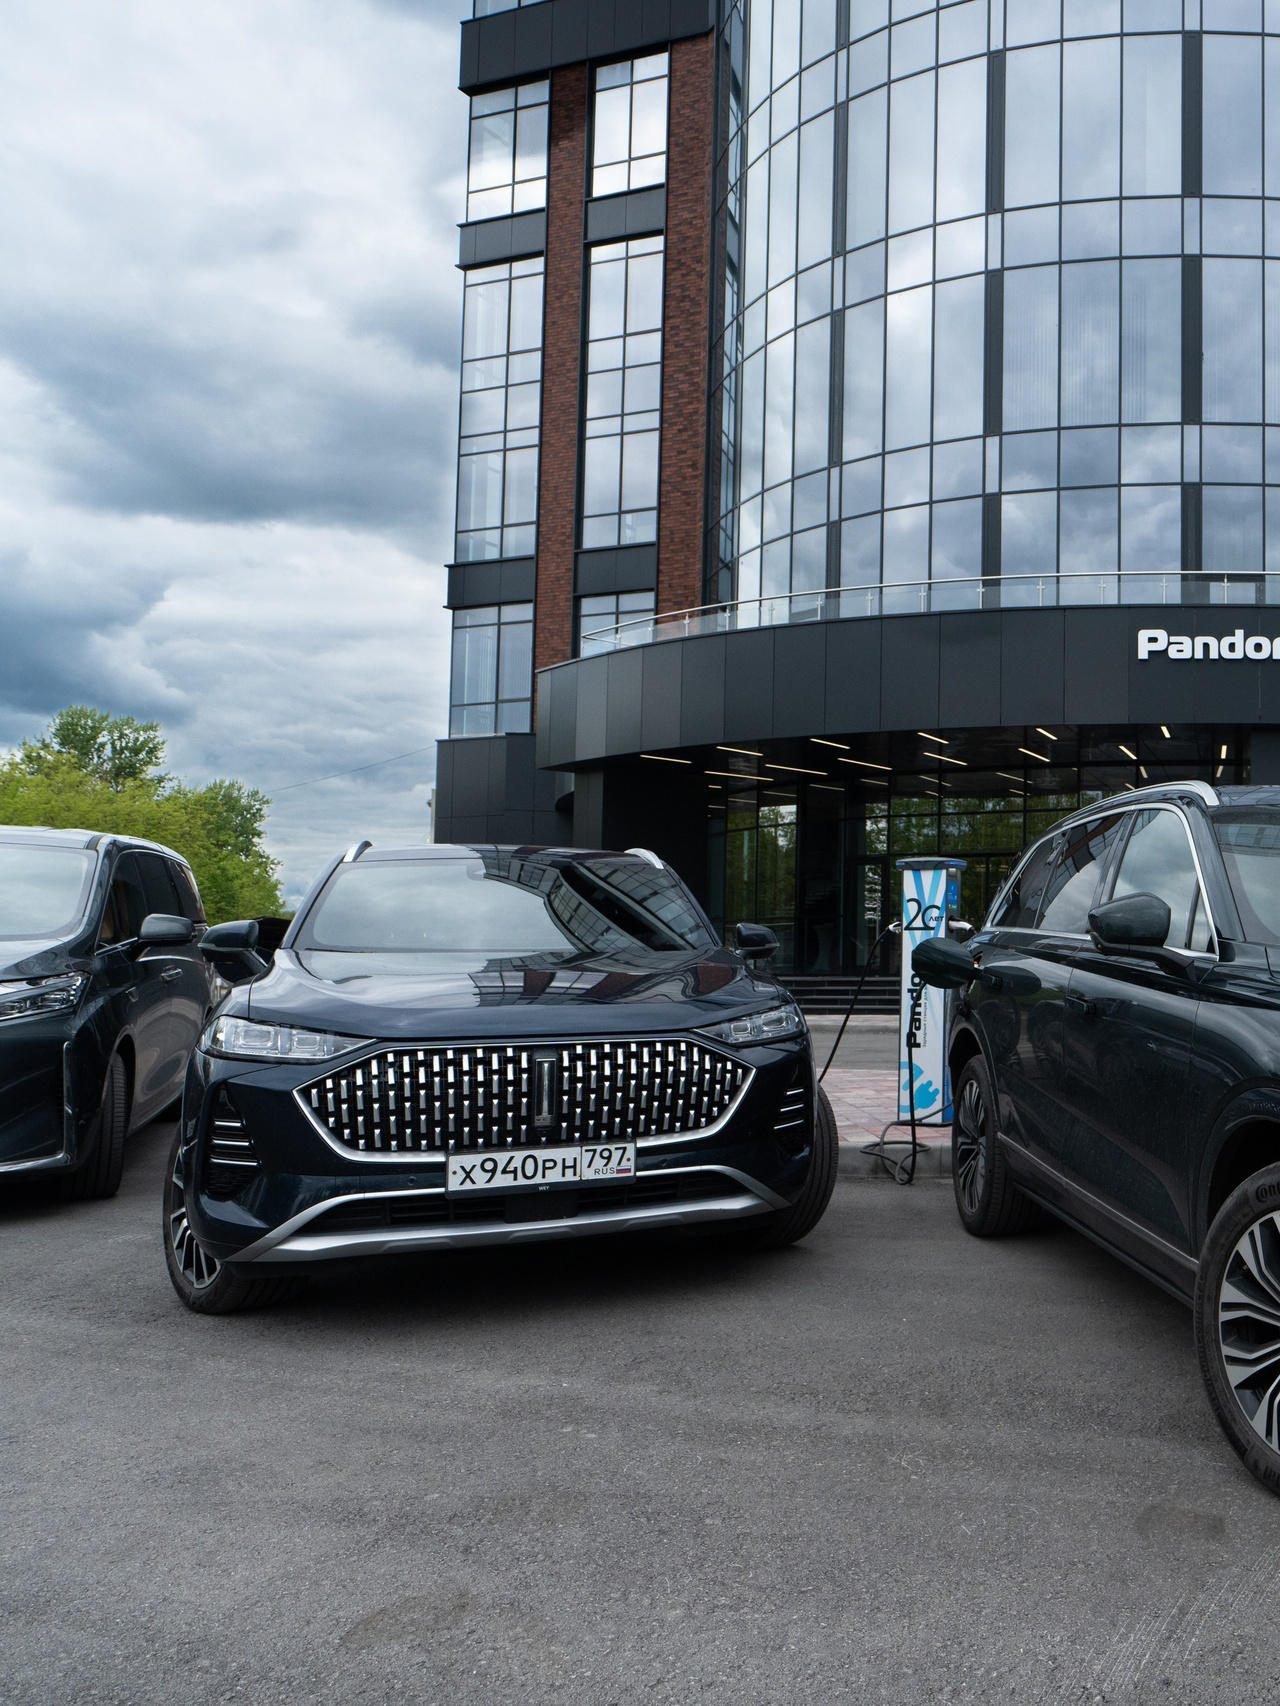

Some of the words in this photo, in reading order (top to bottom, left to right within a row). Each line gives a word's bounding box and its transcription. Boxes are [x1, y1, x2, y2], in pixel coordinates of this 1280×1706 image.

[906, 971, 921, 1049] Pando
[584, 1146, 628, 1169] 797
[594, 1166, 615, 1176] RUS
